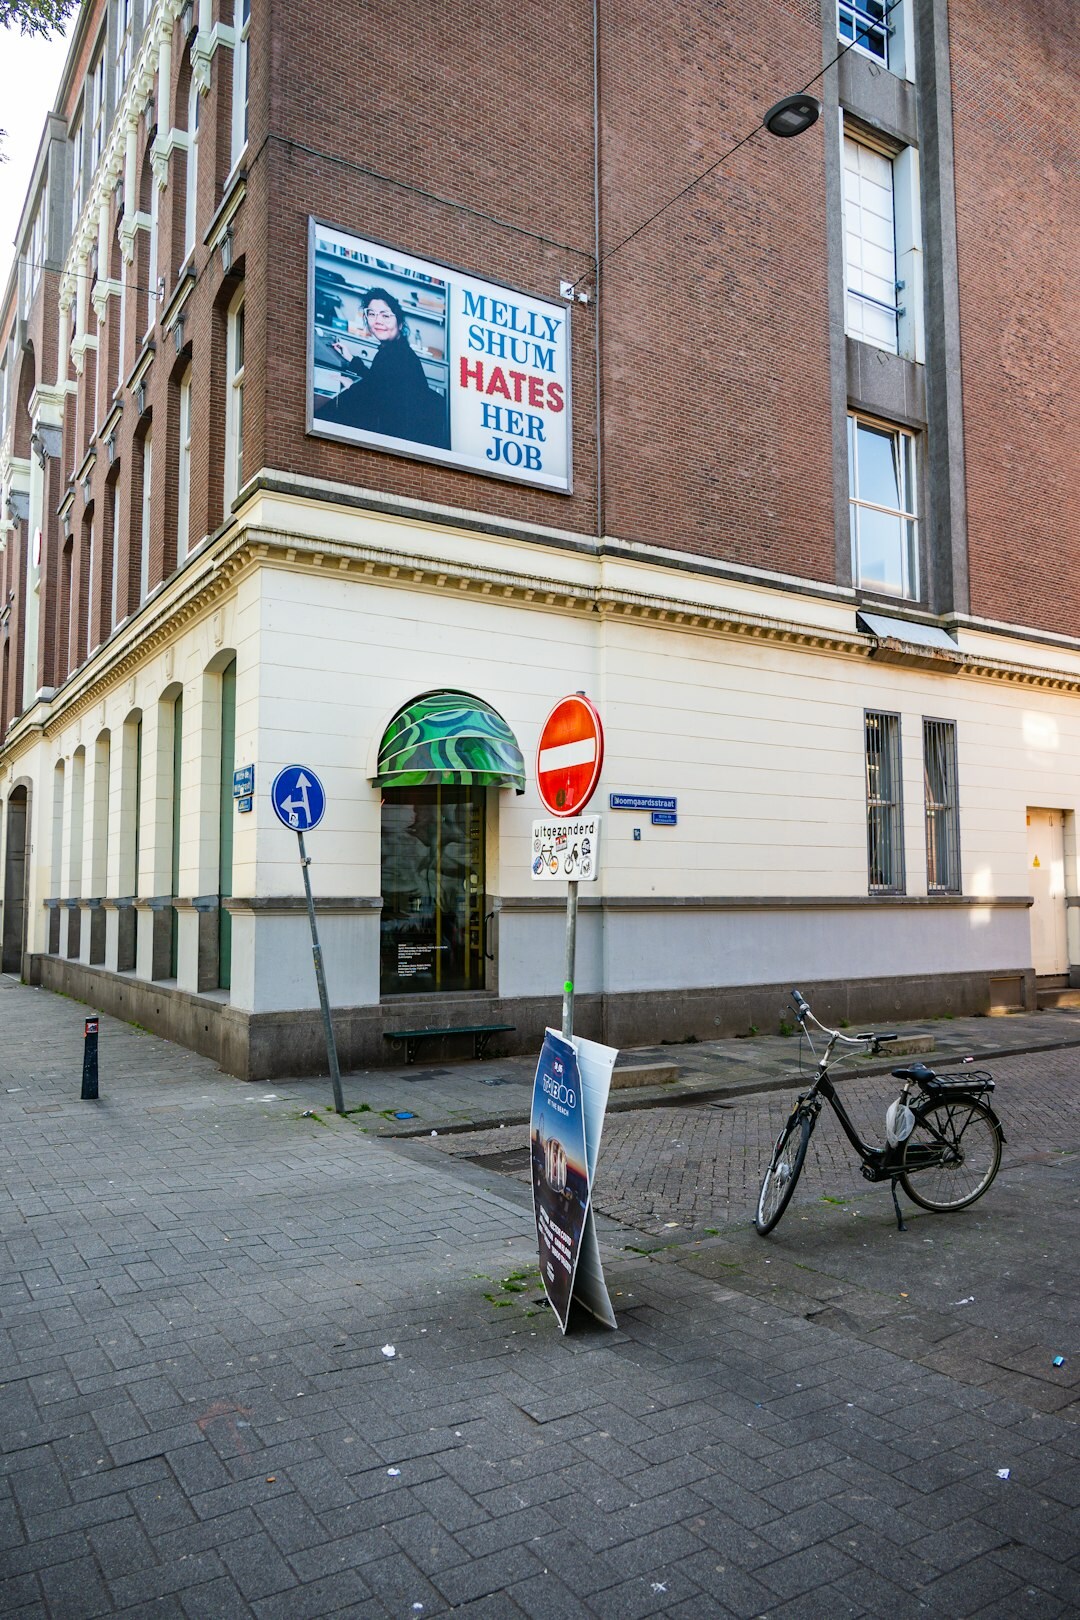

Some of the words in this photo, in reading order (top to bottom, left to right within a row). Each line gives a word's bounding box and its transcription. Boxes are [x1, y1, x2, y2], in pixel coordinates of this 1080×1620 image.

[462, 289, 562, 344] MELLY
[468, 324, 556, 373] SHUM
[460, 356, 564, 413] HATES
[480, 402, 546, 442] HER
[486, 436, 543, 471] JOB
[535, 821, 594, 840] uitgezonderd
[543, 1073, 576, 1109] TABOO
[557, 1103, 569, 1117] BEACH
